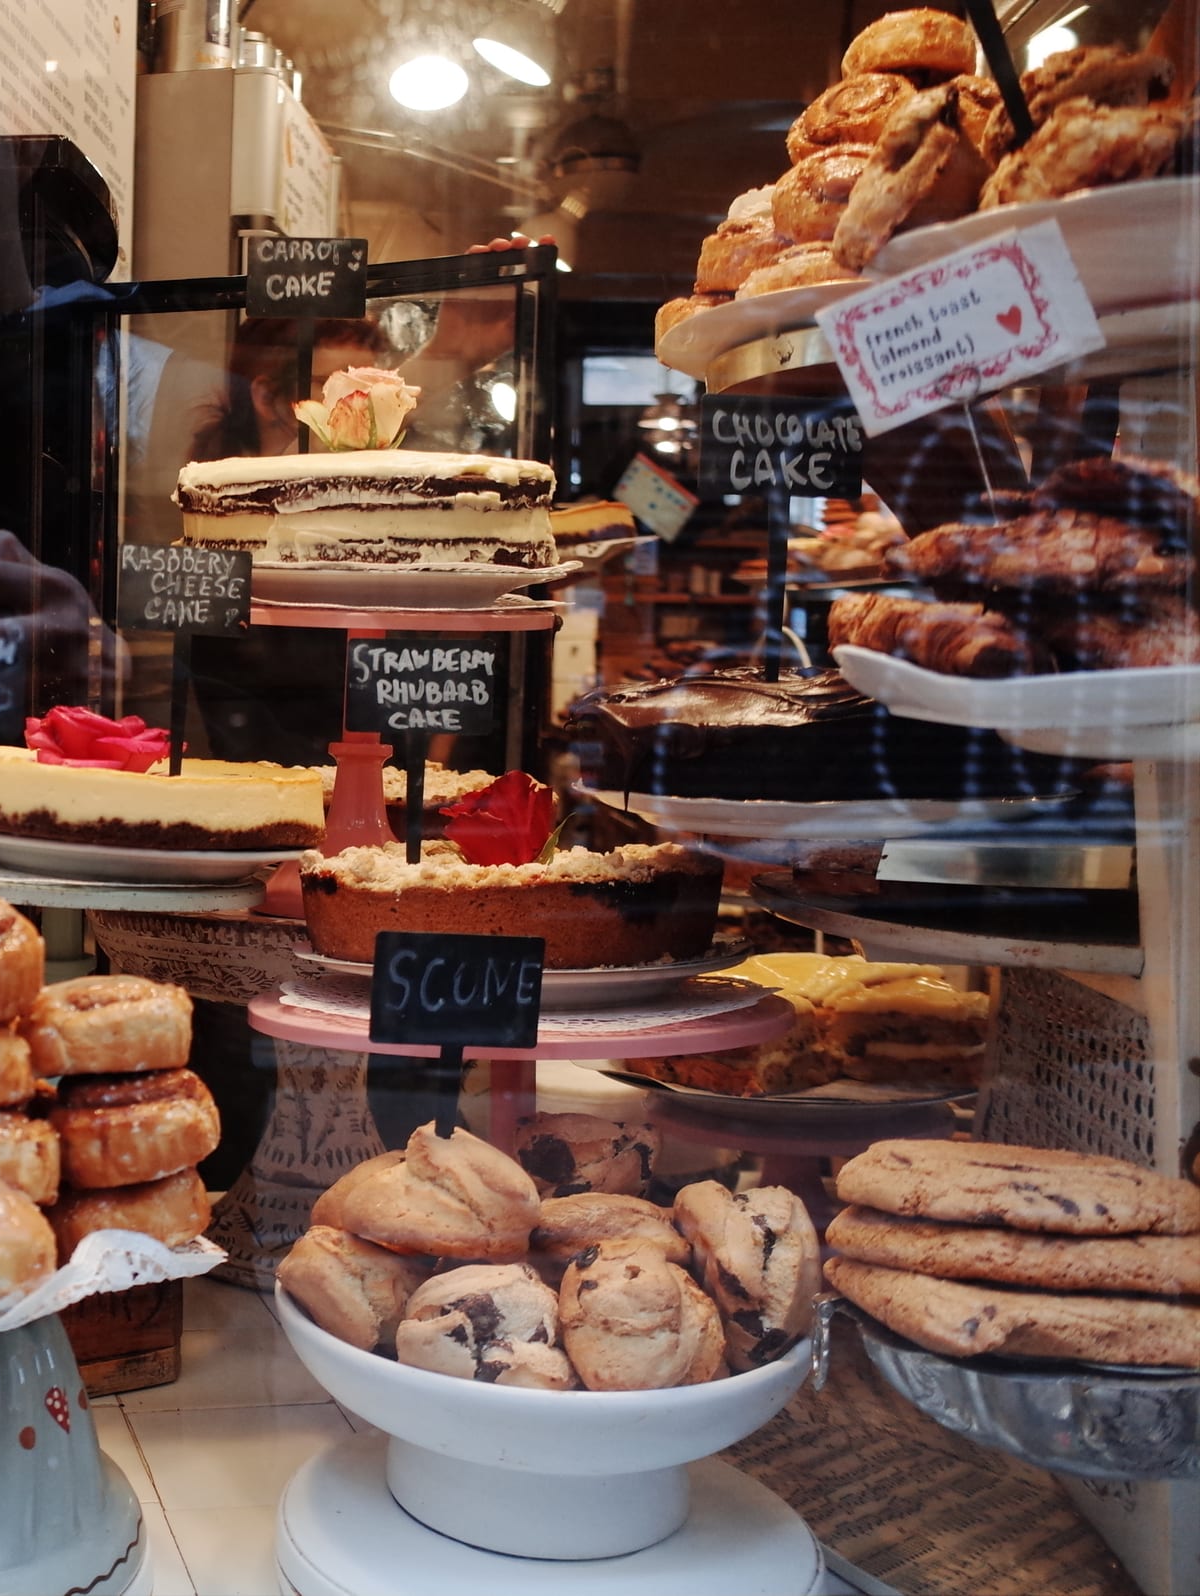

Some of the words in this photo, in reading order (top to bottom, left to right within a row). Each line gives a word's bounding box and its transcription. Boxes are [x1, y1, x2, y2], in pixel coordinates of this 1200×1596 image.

[266, 271, 335, 300] CAKE
[928, 288, 982, 322] toast
[870, 329, 942, 372] (almond
[880, 333, 976, 388] croissant)
[712, 409, 863, 452] CHOCOLATE
[730, 449, 834, 491] CAKE
[151, 572, 246, 599] CHEESE
[144, 597, 211, 627] CAKE
[353, 643, 496, 683] STRAWBERRY
[376, 678, 490, 706] RHUBARB
[388, 707, 463, 731] CAKE
